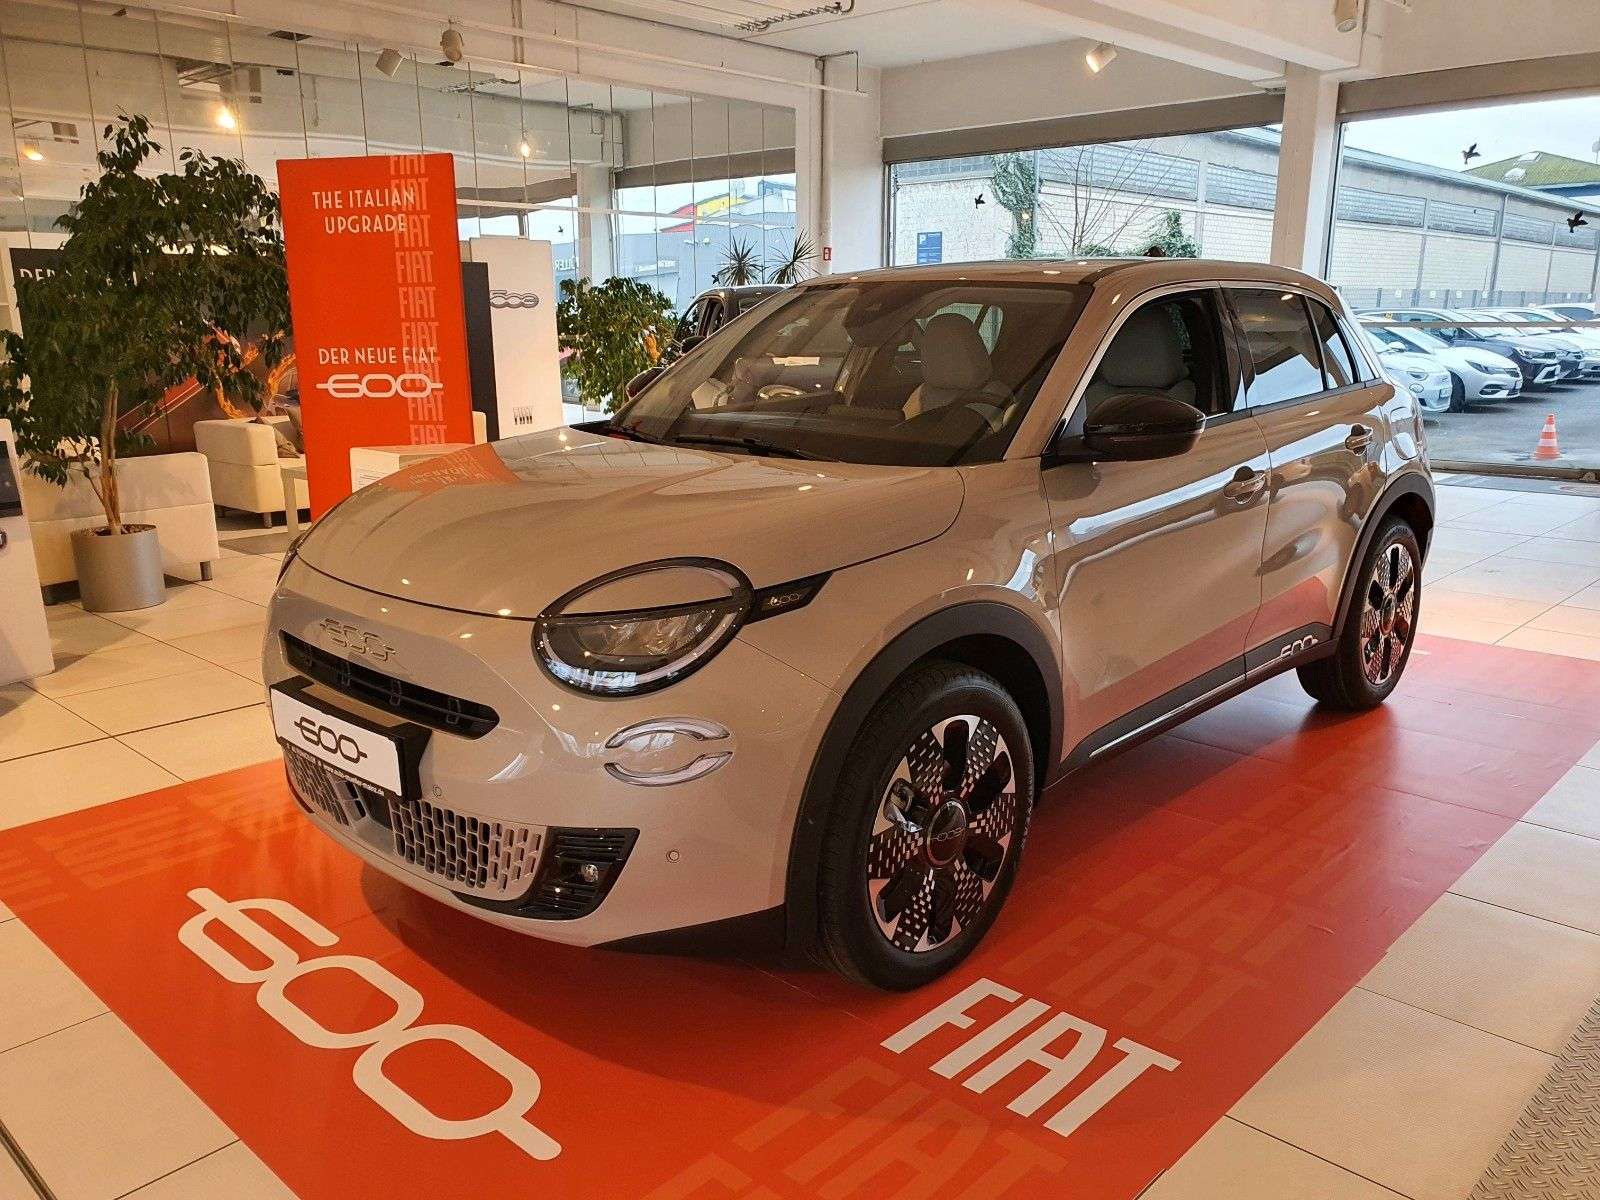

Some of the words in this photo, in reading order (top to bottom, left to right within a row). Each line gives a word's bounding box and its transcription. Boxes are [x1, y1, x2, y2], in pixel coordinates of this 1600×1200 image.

[312, 190, 343, 209] THE
[349, 187, 416, 208] ITALIAN
[390, 177, 429, 211] FIAT
[324, 213, 408, 234] UPGRADE
[395, 250, 434, 283] FIAT
[399, 286, 437, 319] FIAT
[401, 321, 440, 354] FIAT
[319, 348, 350, 365] DER
[355, 347, 397, 364] NEUE
[402, 346, 438, 364] FIAT
[315, 373, 444, 398] 600
[319, 617, 396, 662] 600
[293, 716, 368, 764] 600
[177, 887, 563, 1161] 600
[879, 977, 1183, 1138] FIAT
